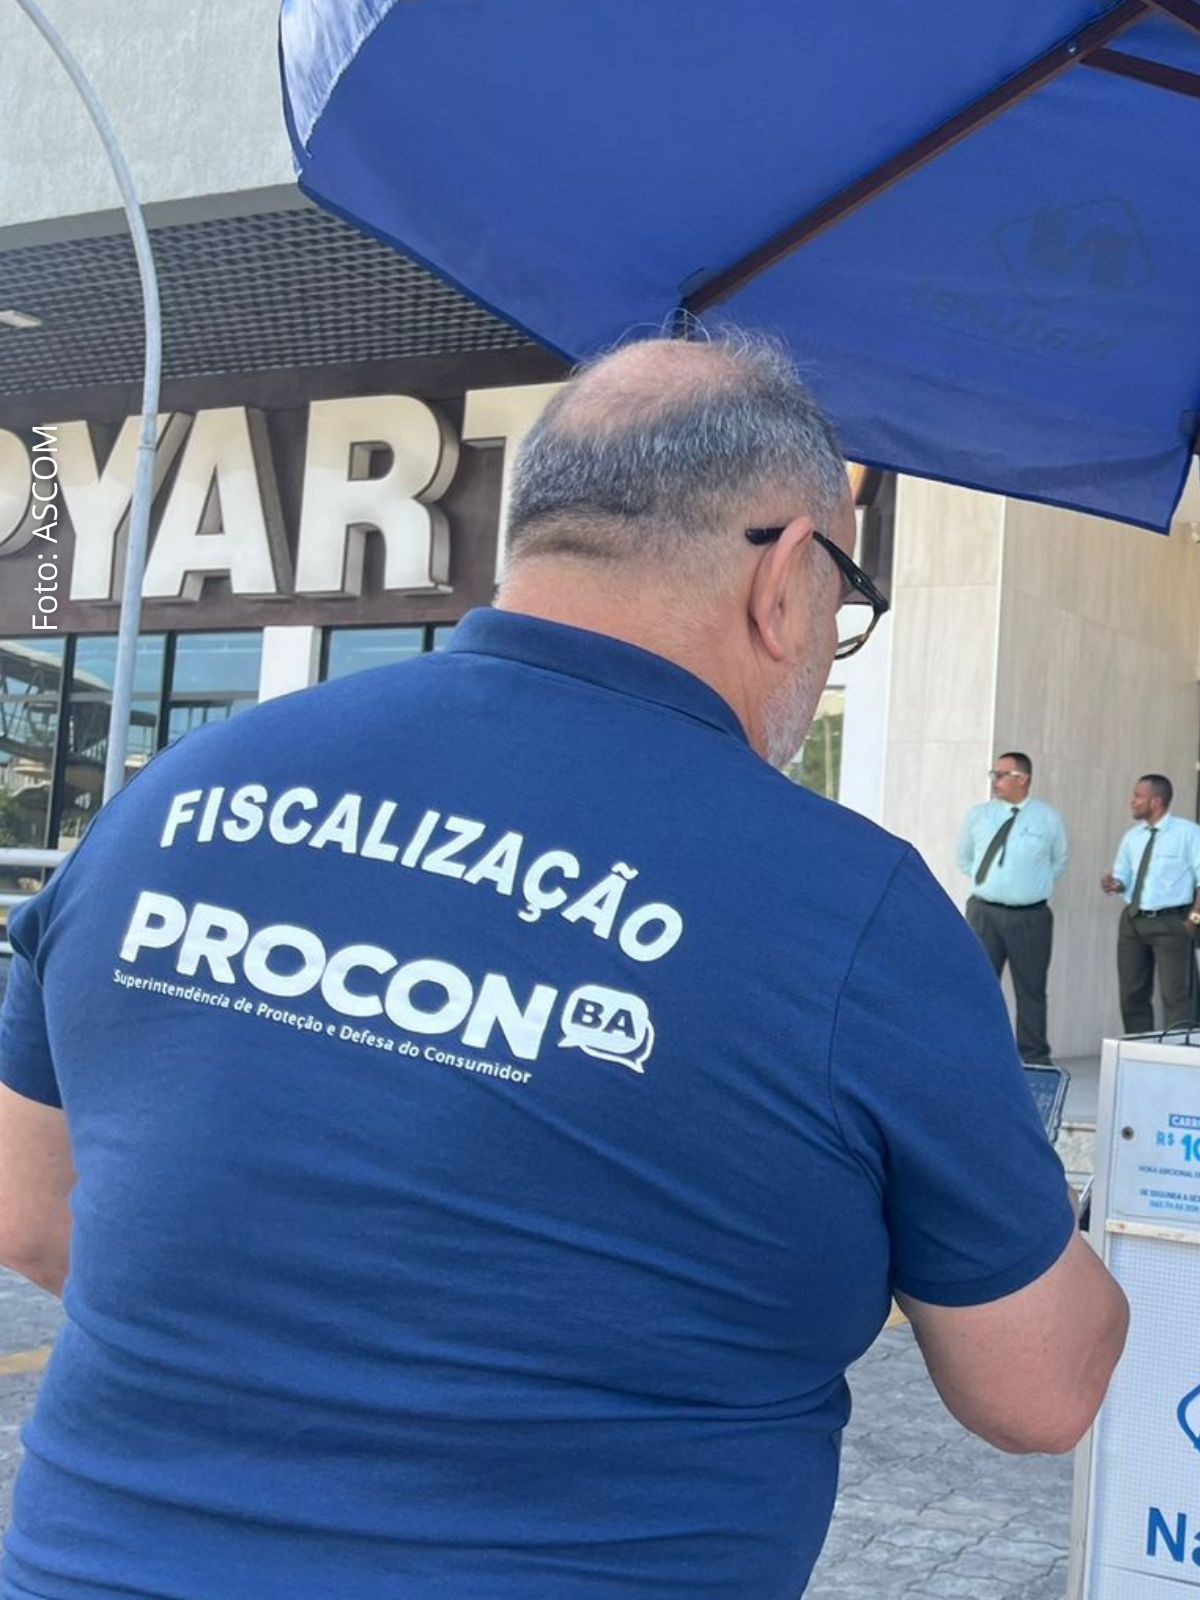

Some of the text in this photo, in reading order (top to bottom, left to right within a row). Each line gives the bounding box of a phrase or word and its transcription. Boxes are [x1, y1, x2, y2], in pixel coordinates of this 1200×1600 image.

[160, 784, 684, 962] FISCALIZAÇÃO
[112, 968, 532, 1084] Superintendência de Proteção e Defesa do Consumidor
[119, 890, 637, 1061] PROCON BA
[1156, 1131, 1175, 1147] R$
